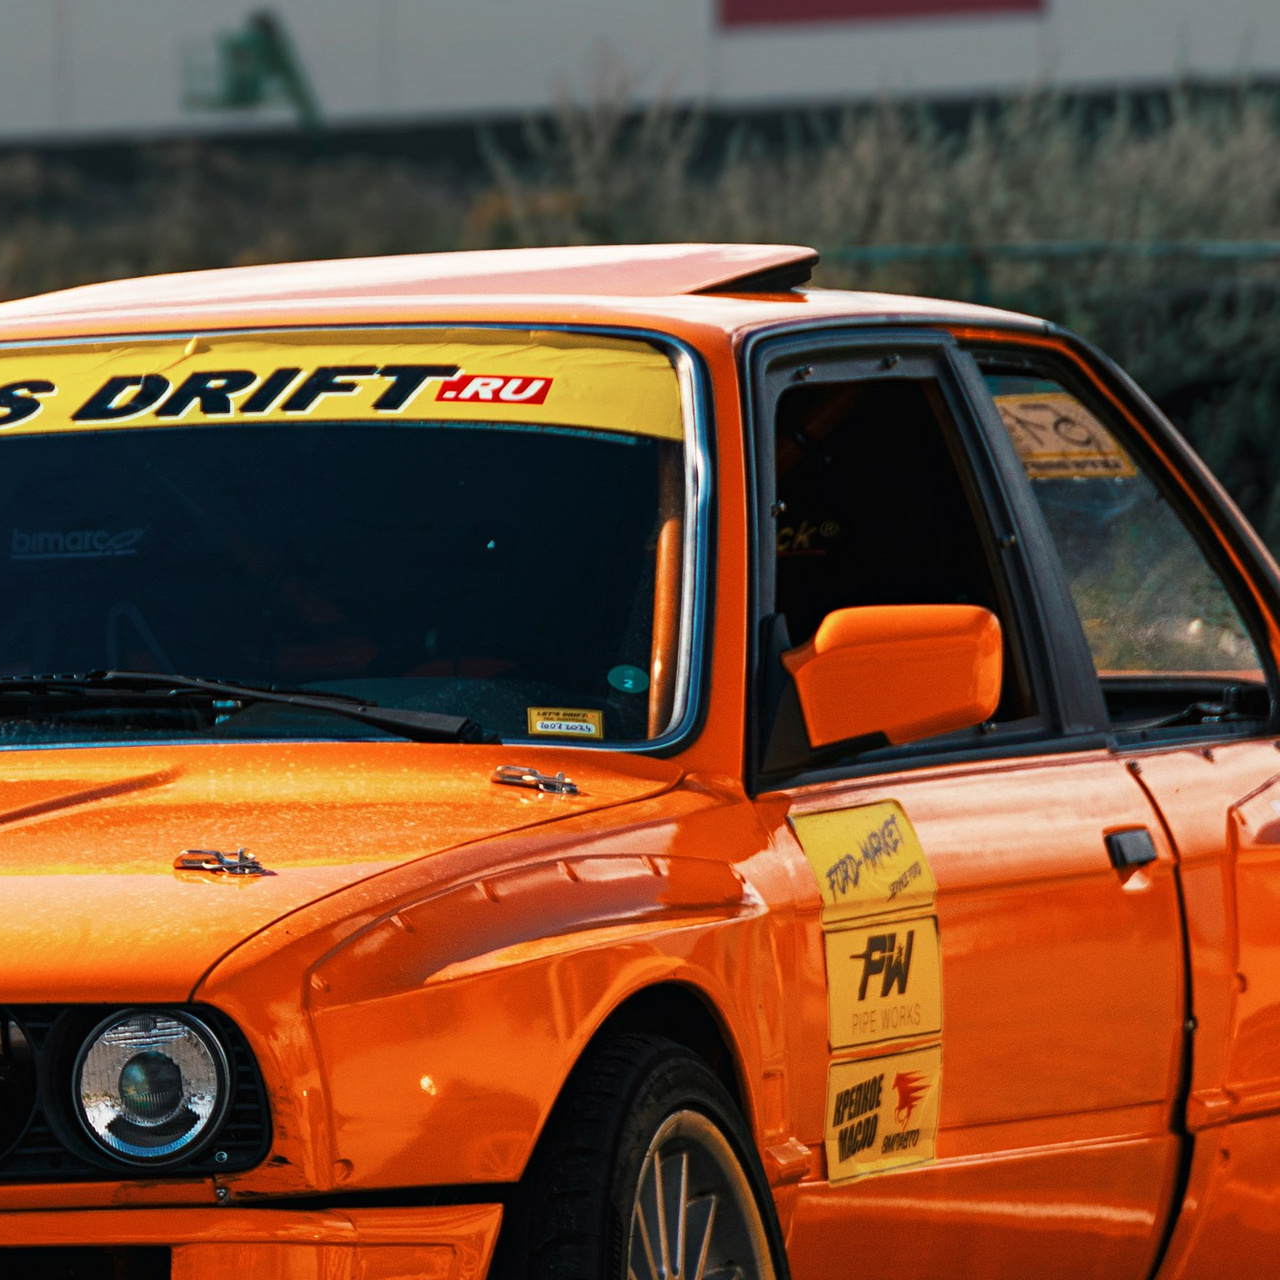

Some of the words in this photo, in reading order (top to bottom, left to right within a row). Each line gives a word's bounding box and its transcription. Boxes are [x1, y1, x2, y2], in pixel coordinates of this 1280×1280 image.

[851, 1010, 877, 1035] PIPE
[881, 1003, 921, 1030] WORKS
[832, 1073, 885, 1127] КРЕПКОЕ
[838, 1113, 879, 1163] МАСЛО
